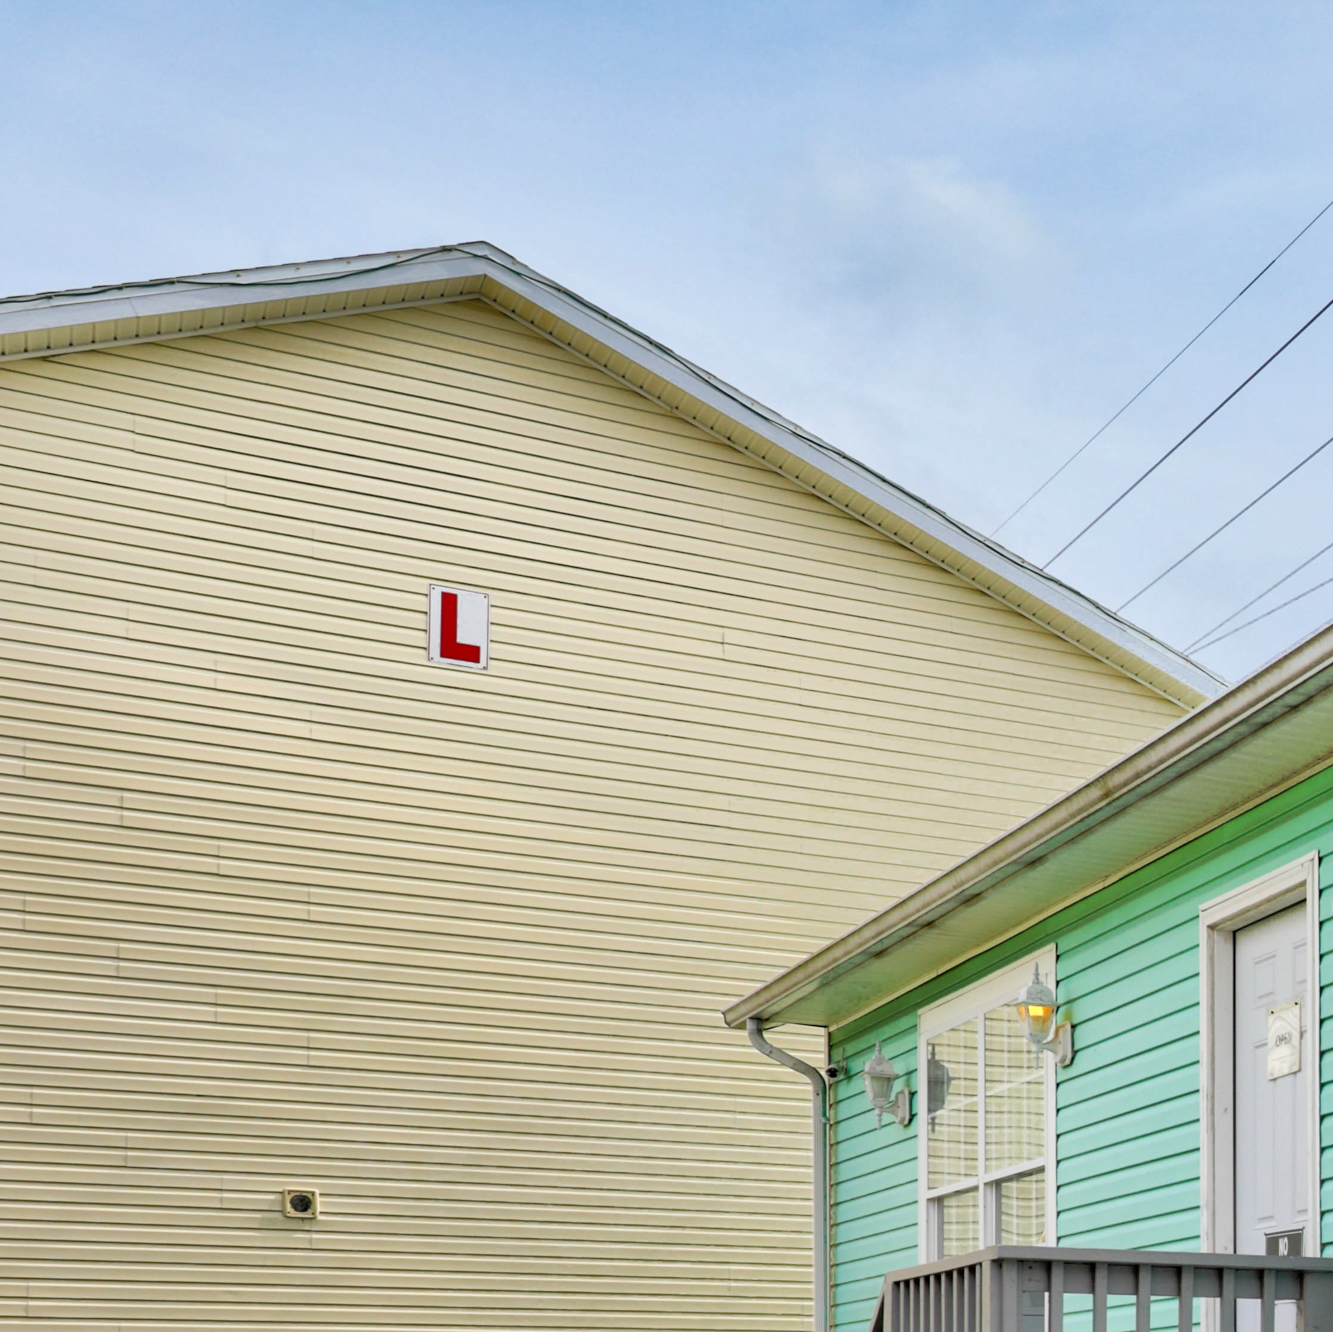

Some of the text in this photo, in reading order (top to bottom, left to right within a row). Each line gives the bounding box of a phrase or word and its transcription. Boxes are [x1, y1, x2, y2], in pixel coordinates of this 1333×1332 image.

[440, 591, 481, 664] L
[1275, 1031, 1293, 1047] OPEN
[1278, 1236, 1289, 1257] NO
